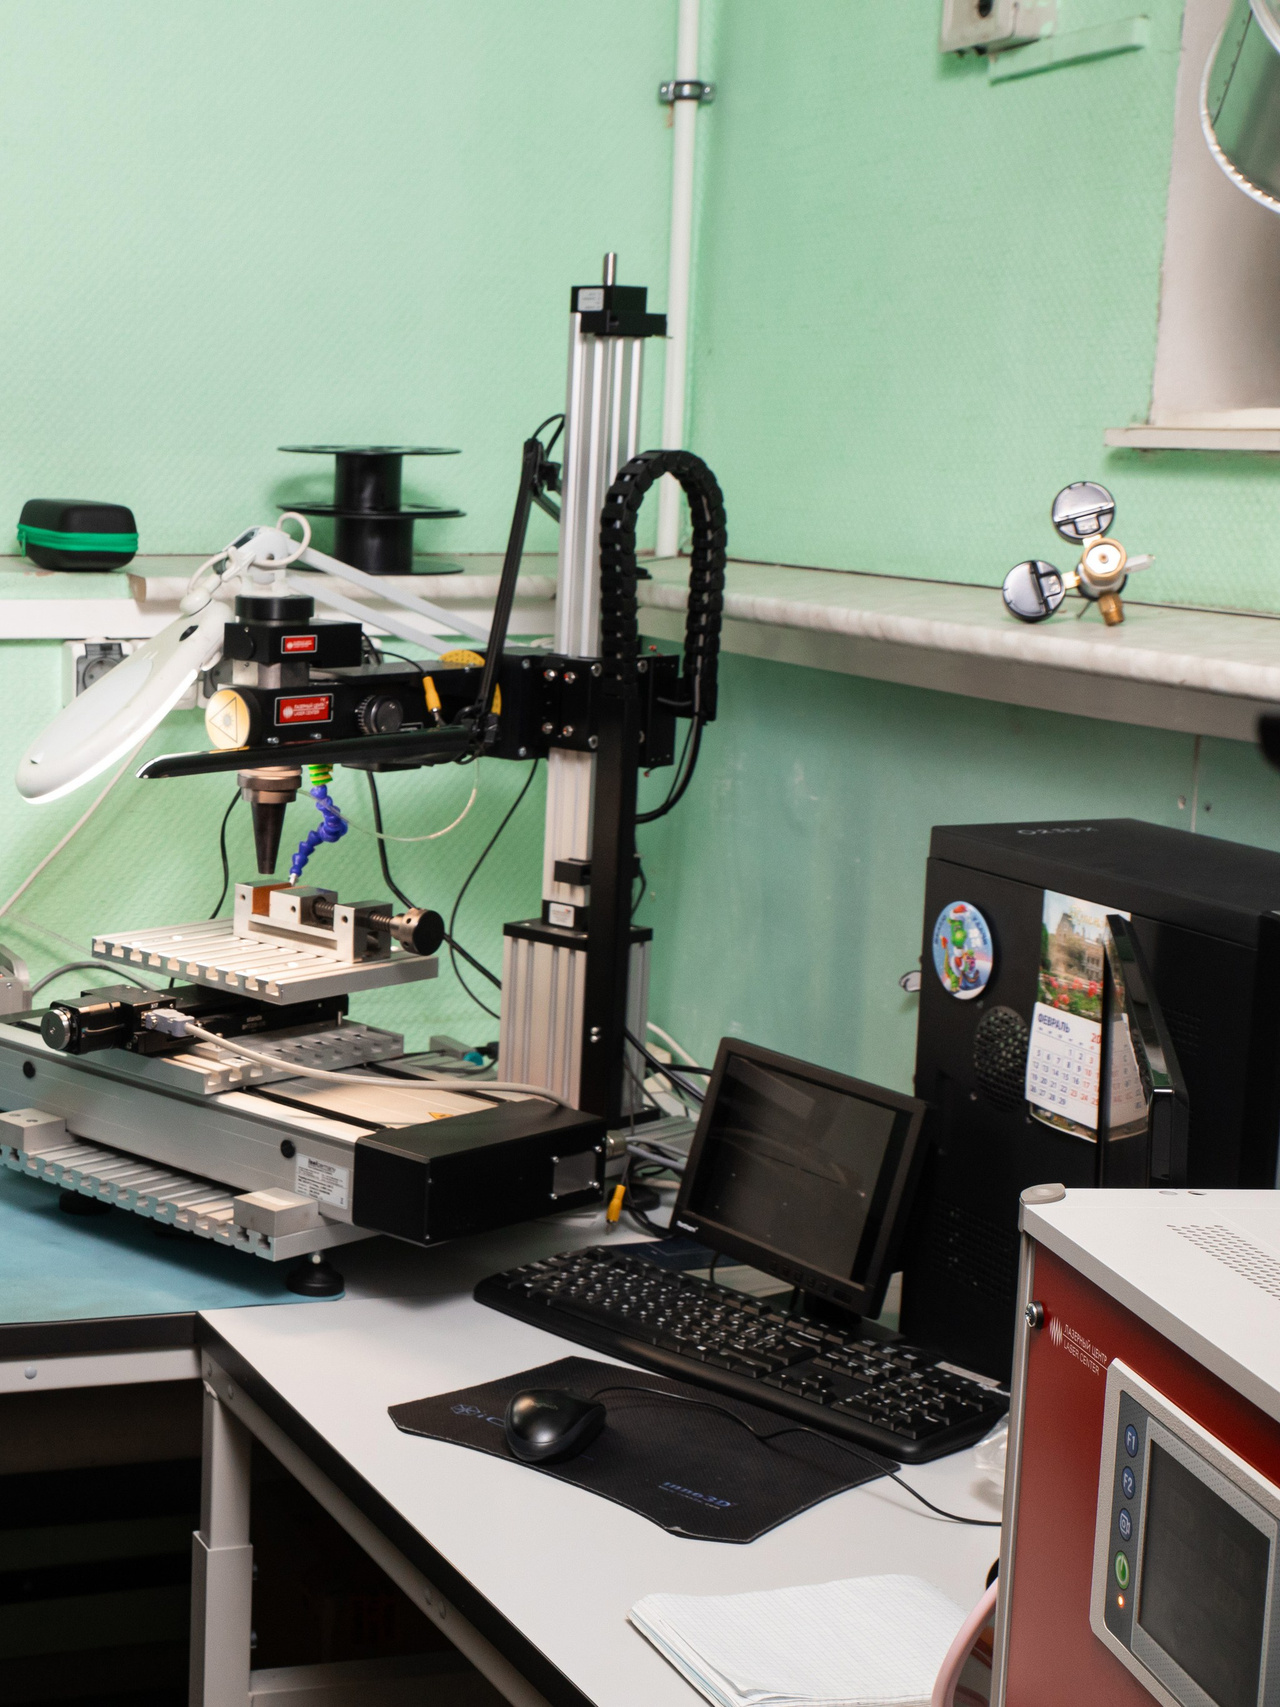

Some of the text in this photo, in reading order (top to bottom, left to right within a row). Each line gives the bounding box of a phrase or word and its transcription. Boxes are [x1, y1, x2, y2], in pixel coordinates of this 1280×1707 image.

[1038, 1013, 1071, 1033] ФЕВРАЛЬ
[1064, 1324, 1107, 1364] ЛАЗЕРНЫЙ ЦЕНТР
[1064, 1340, 1099, 1376] LASER CENTER
[1127, 1431, 1135, 1450] F1
[1124, 1473, 1132, 1493] F2
